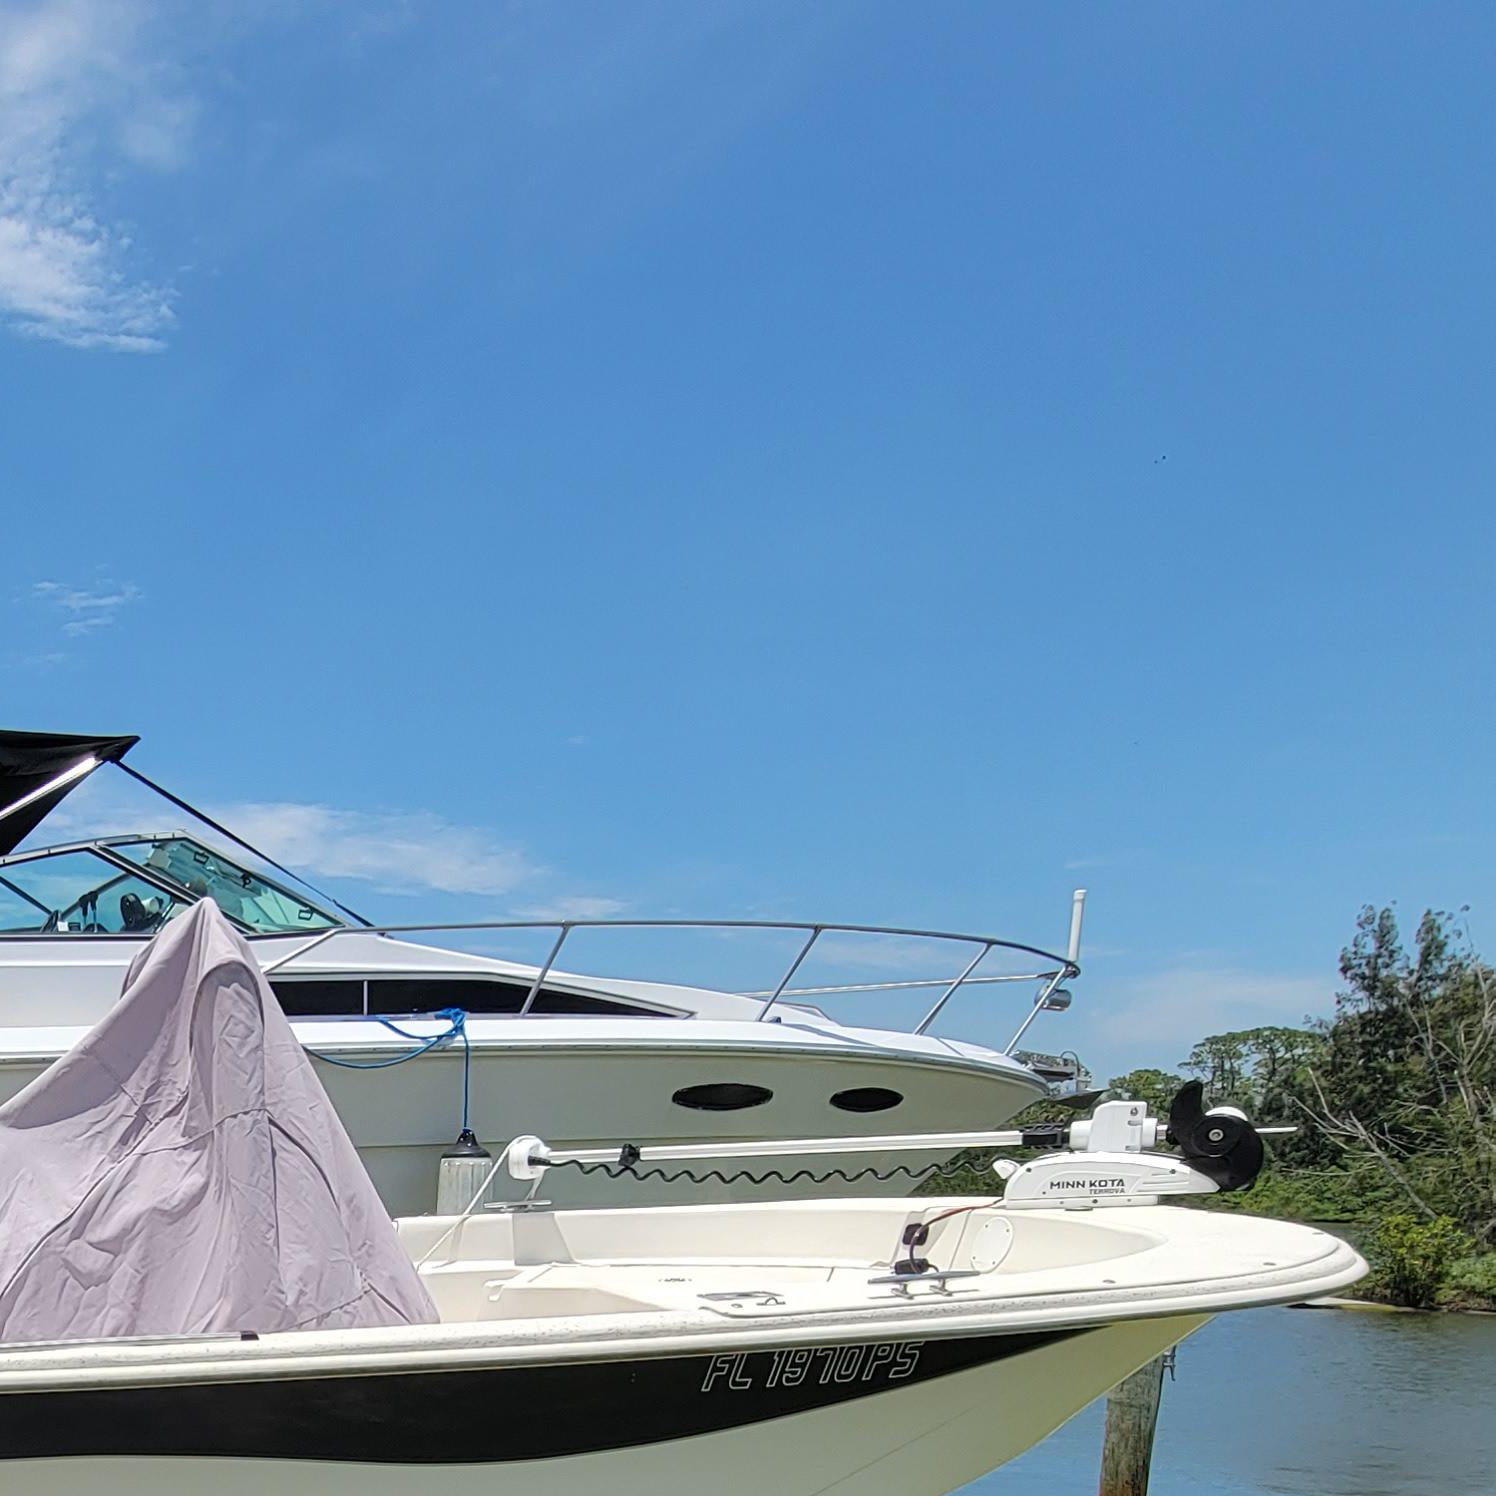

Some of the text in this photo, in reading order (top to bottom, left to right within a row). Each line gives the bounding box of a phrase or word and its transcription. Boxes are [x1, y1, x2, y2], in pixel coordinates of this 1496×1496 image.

[1049, 1178, 1126, 1190] MINN KOTA
[701, 1340, 926, 1393] FL 1970PS
